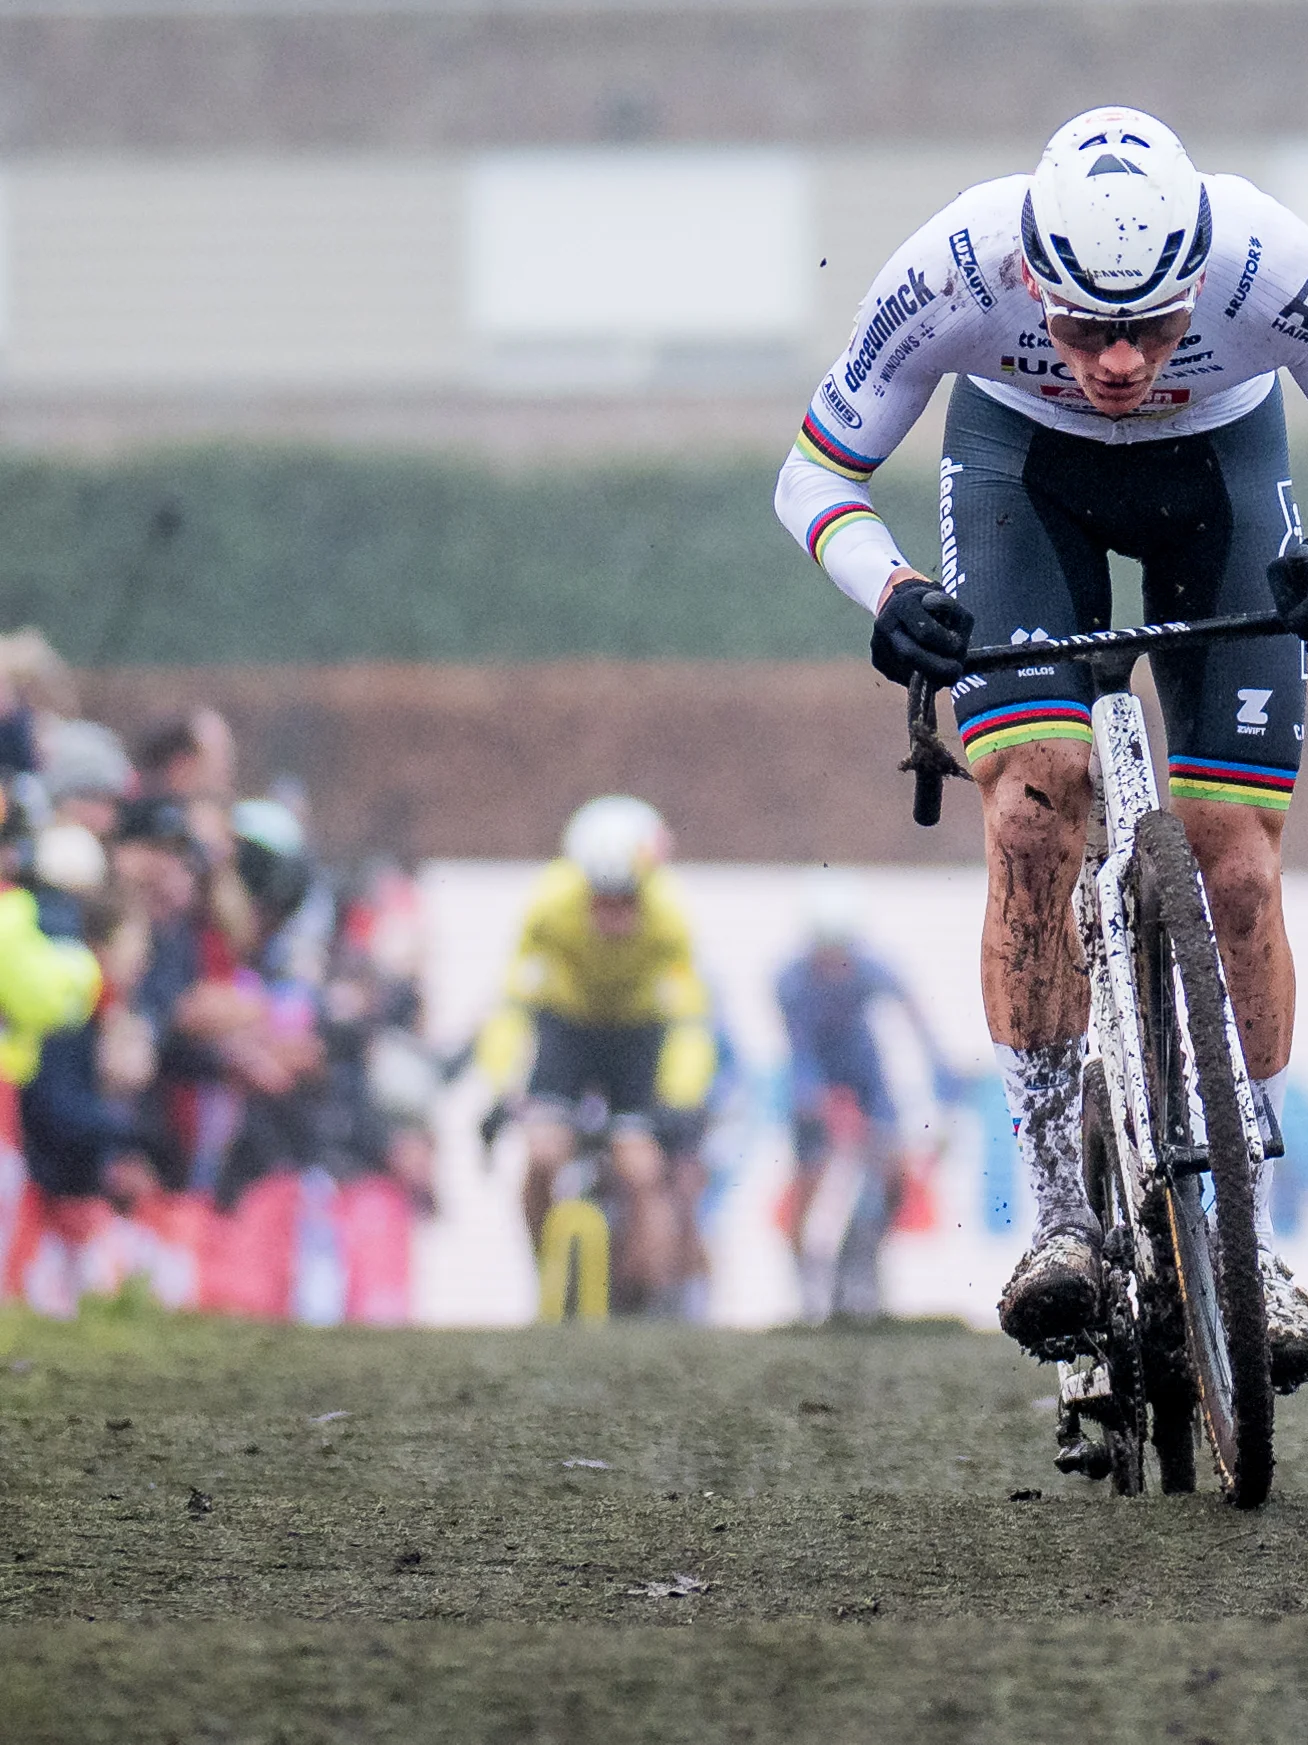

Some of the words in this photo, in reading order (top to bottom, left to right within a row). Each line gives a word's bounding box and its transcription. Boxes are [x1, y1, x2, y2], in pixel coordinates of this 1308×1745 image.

[1093, 269, 1143, 279] CANYON
[1225, 249, 1261, 319] BRUSTOR
[844, 267, 936, 393] deceuninck
[880, 335, 920, 383] WINDOWS
[824, 381, 855, 423] ABUS
[1237, 725, 1266, 736] ZWIFT
